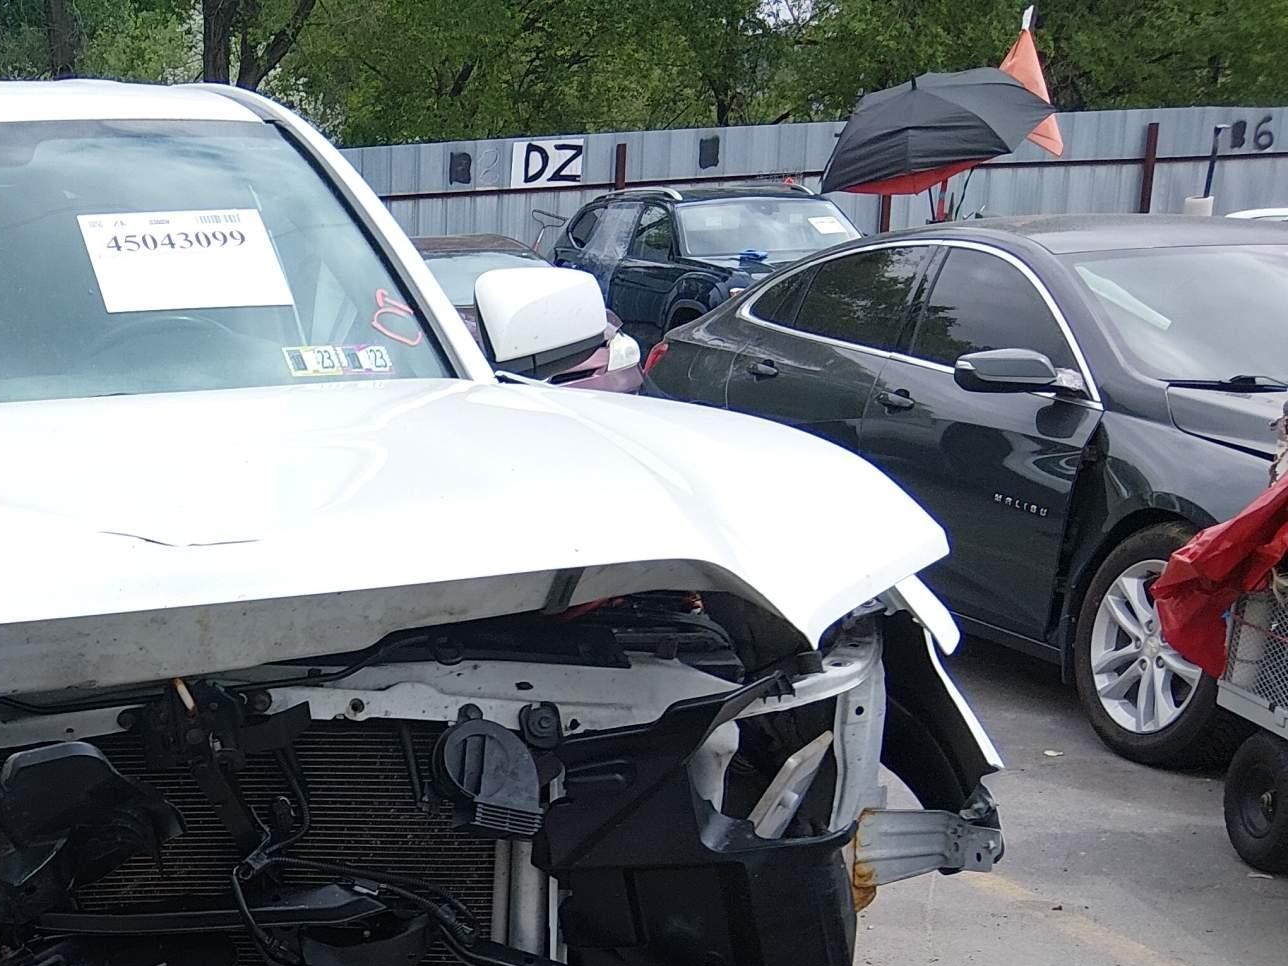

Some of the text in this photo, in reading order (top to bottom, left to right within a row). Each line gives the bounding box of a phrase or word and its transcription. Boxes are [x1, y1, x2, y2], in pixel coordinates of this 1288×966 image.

[523, 142, 584, 184] DZ
[106, 229, 247, 253] 45043099
[994, 493, 1049, 517] MALIBU
